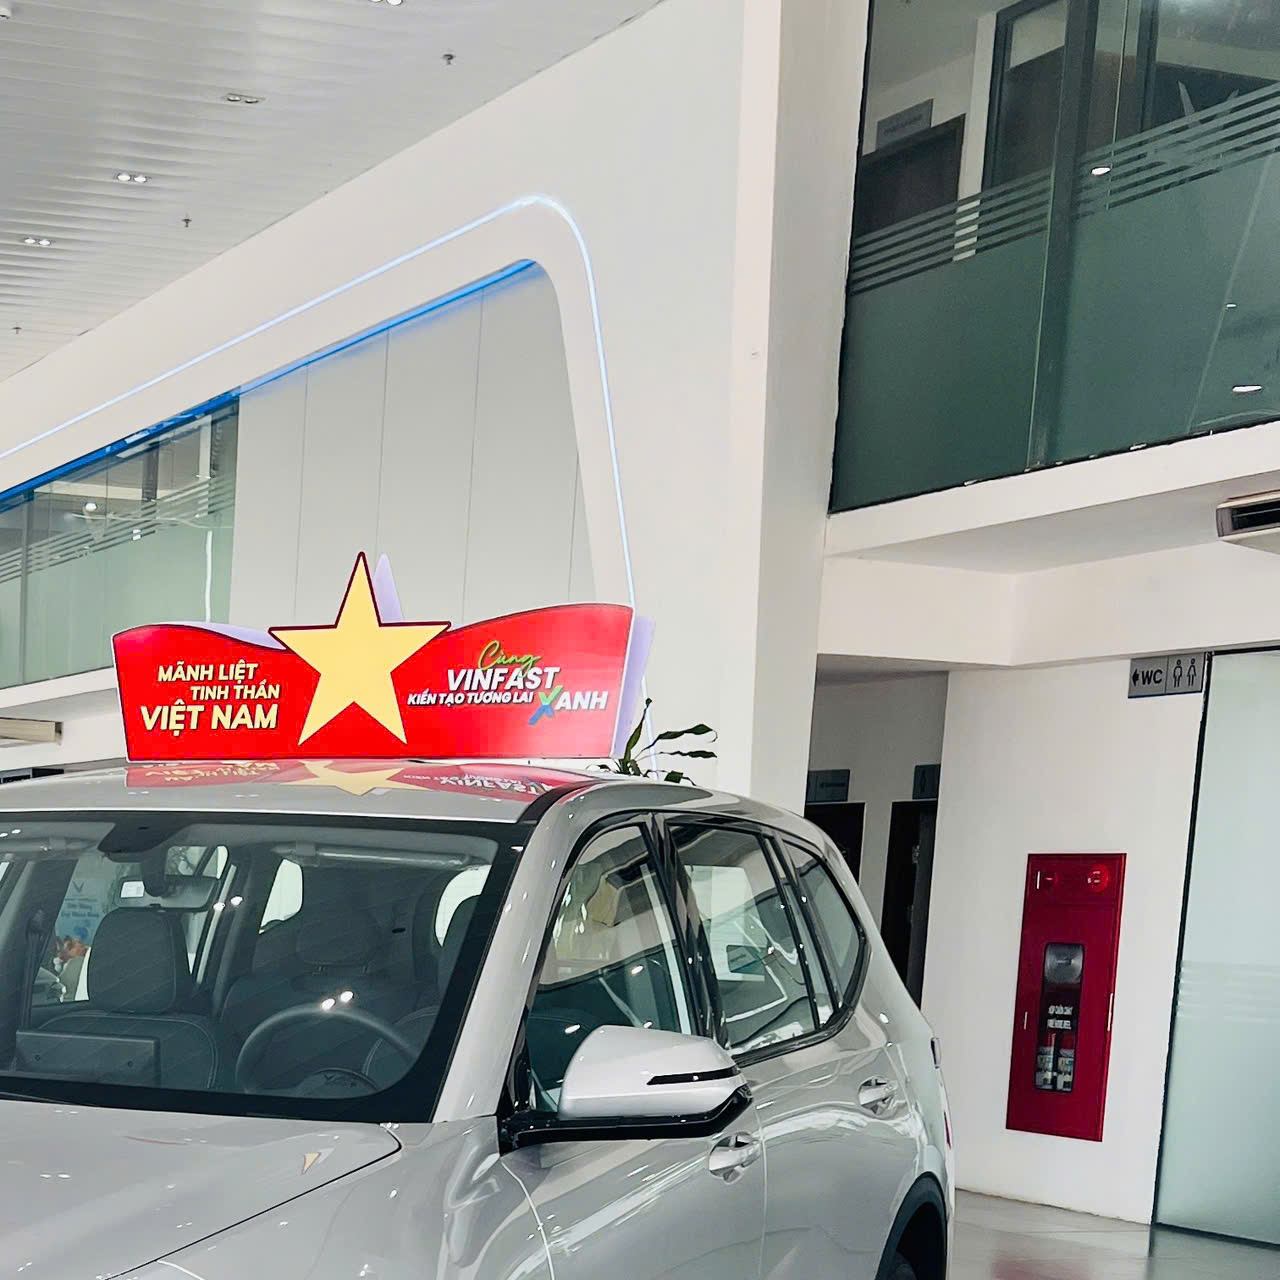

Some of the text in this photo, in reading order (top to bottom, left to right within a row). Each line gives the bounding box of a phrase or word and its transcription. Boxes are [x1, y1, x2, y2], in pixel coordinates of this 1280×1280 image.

[157, 658, 259, 684] MÃNH LIỆT
[478, 640, 542, 678] Cùng
[447, 666, 561, 691] VINFAST
[1141, 669, 1163, 685] WC
[190, 685, 229, 701] TINH
[438, 692, 465, 707] TẠO
[512, 691, 534, 704] LAI
[140, 698, 279, 737] VIỆT NAM
